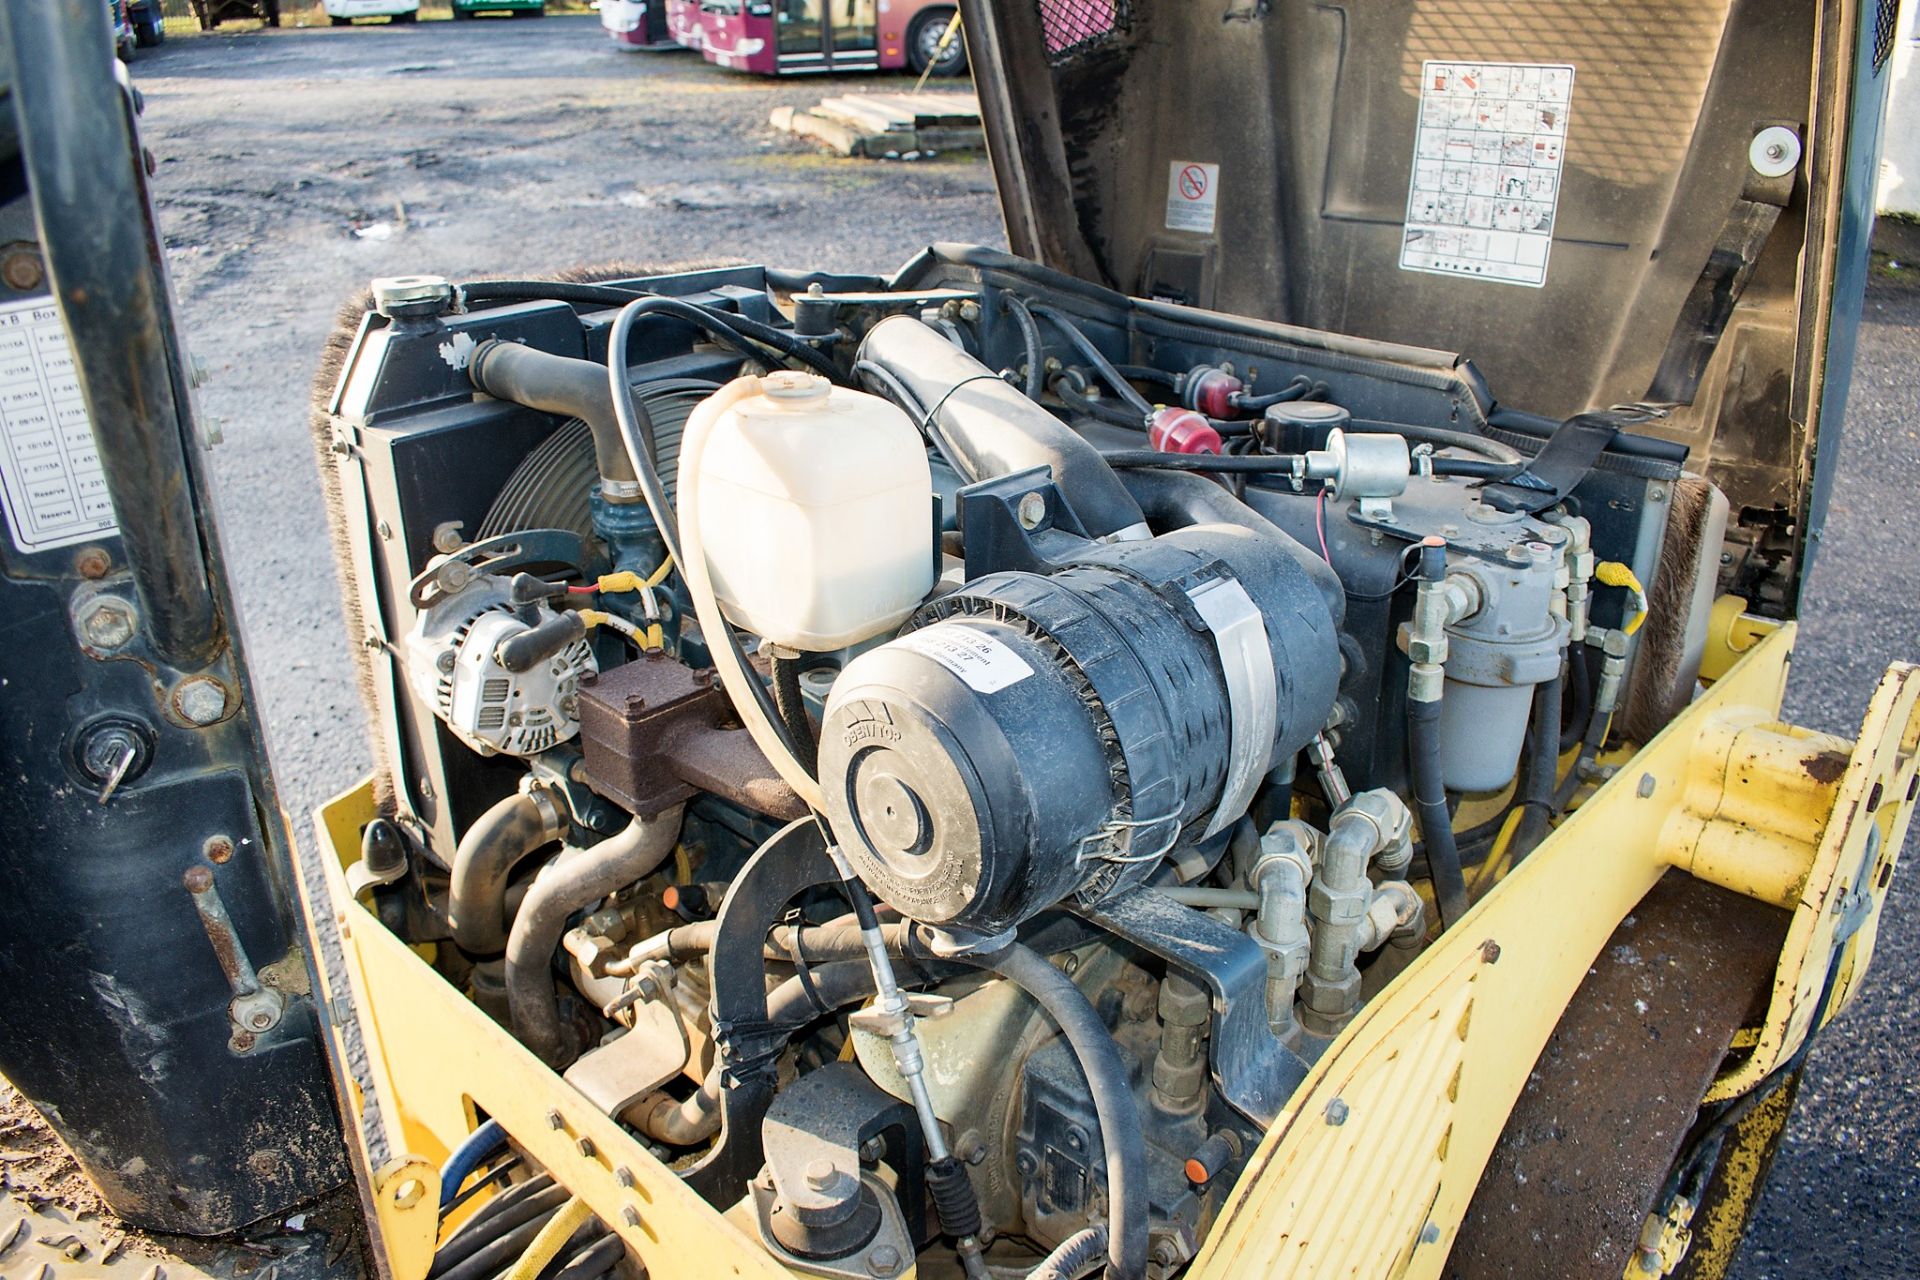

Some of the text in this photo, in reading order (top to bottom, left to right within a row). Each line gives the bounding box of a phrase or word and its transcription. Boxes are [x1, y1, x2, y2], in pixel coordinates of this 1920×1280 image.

[33, 310, 57, 321] Box
[34, 488, 66, 498] Reserve
[40, 509, 72, 520] Reserve
[975, 643, 993, 655] 26
[957, 651, 974, 661] 27
